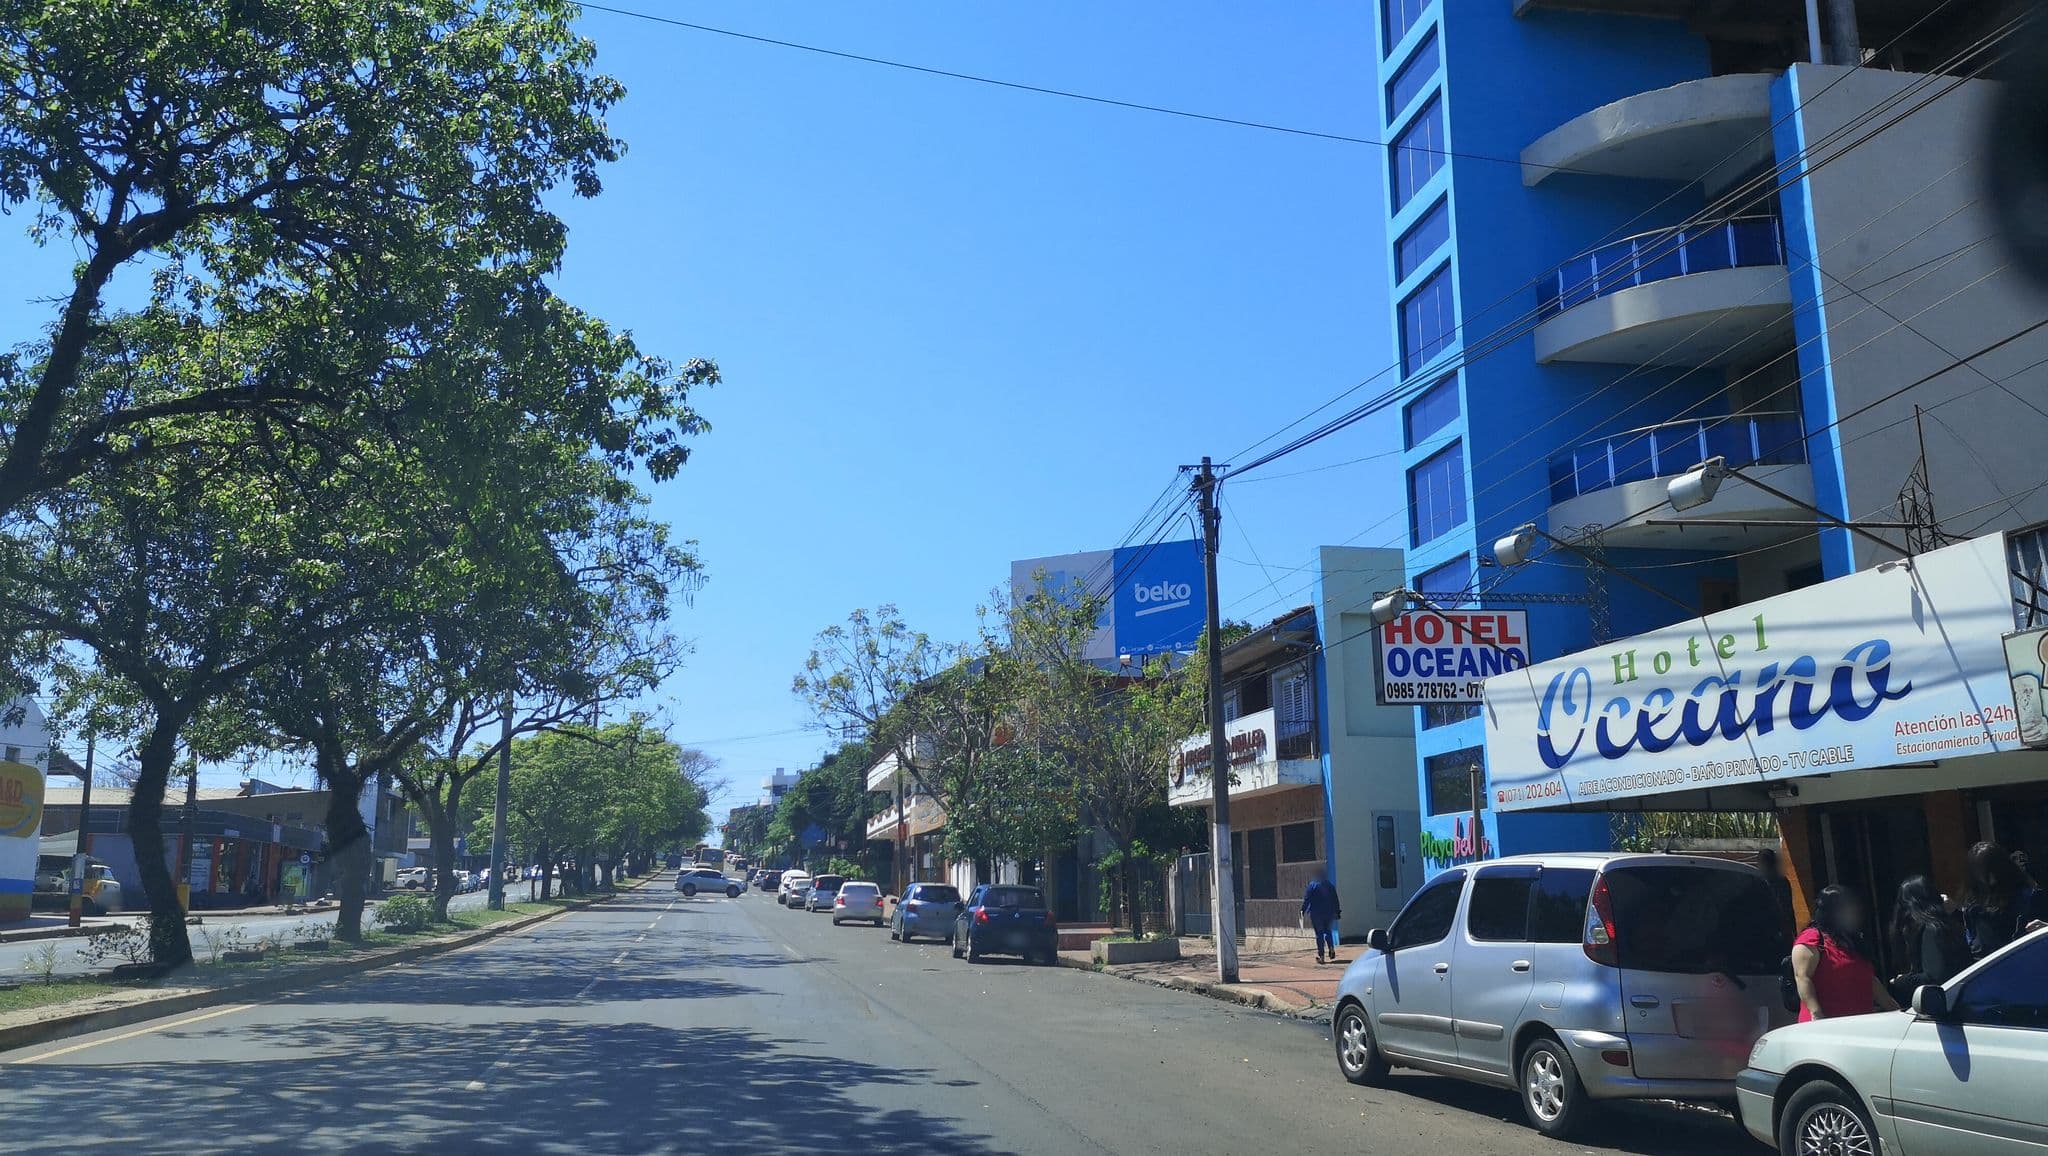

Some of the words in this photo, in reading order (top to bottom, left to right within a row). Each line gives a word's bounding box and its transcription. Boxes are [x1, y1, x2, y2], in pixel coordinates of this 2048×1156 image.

[1135, 581, 1191, 603] beko
[1384, 615, 1521, 645] HOTEL
[1387, 647, 1527, 678] OCEANO
[1612, 612, 1769, 685] Hotel
[1386, 682, 1414, 699] 0985
[1417, 682, 1458, 698] 278762
[1537, 639, 1912, 769] Oceano
[1894, 714, 1956, 737] Atención
[1960, 711, 1980, 727] las
[1896, 734, 1980, 755] Estacionamiento
[1982, 727, 2019, 746] Privad
[1578, 781, 1599, 796] AIRE
[1599, 769, 1684, 794] ACONDICIONADO
[1691, 761, 1724, 781] BAÑO
[1726, 755, 1782, 777] PRIVADO
[1789, 751, 1808, 769] TV
[1809, 745, 1855, 767] CABLE
[1526, 784, 1543, 799] 202
[1545, 780, 1562, 797] 604
